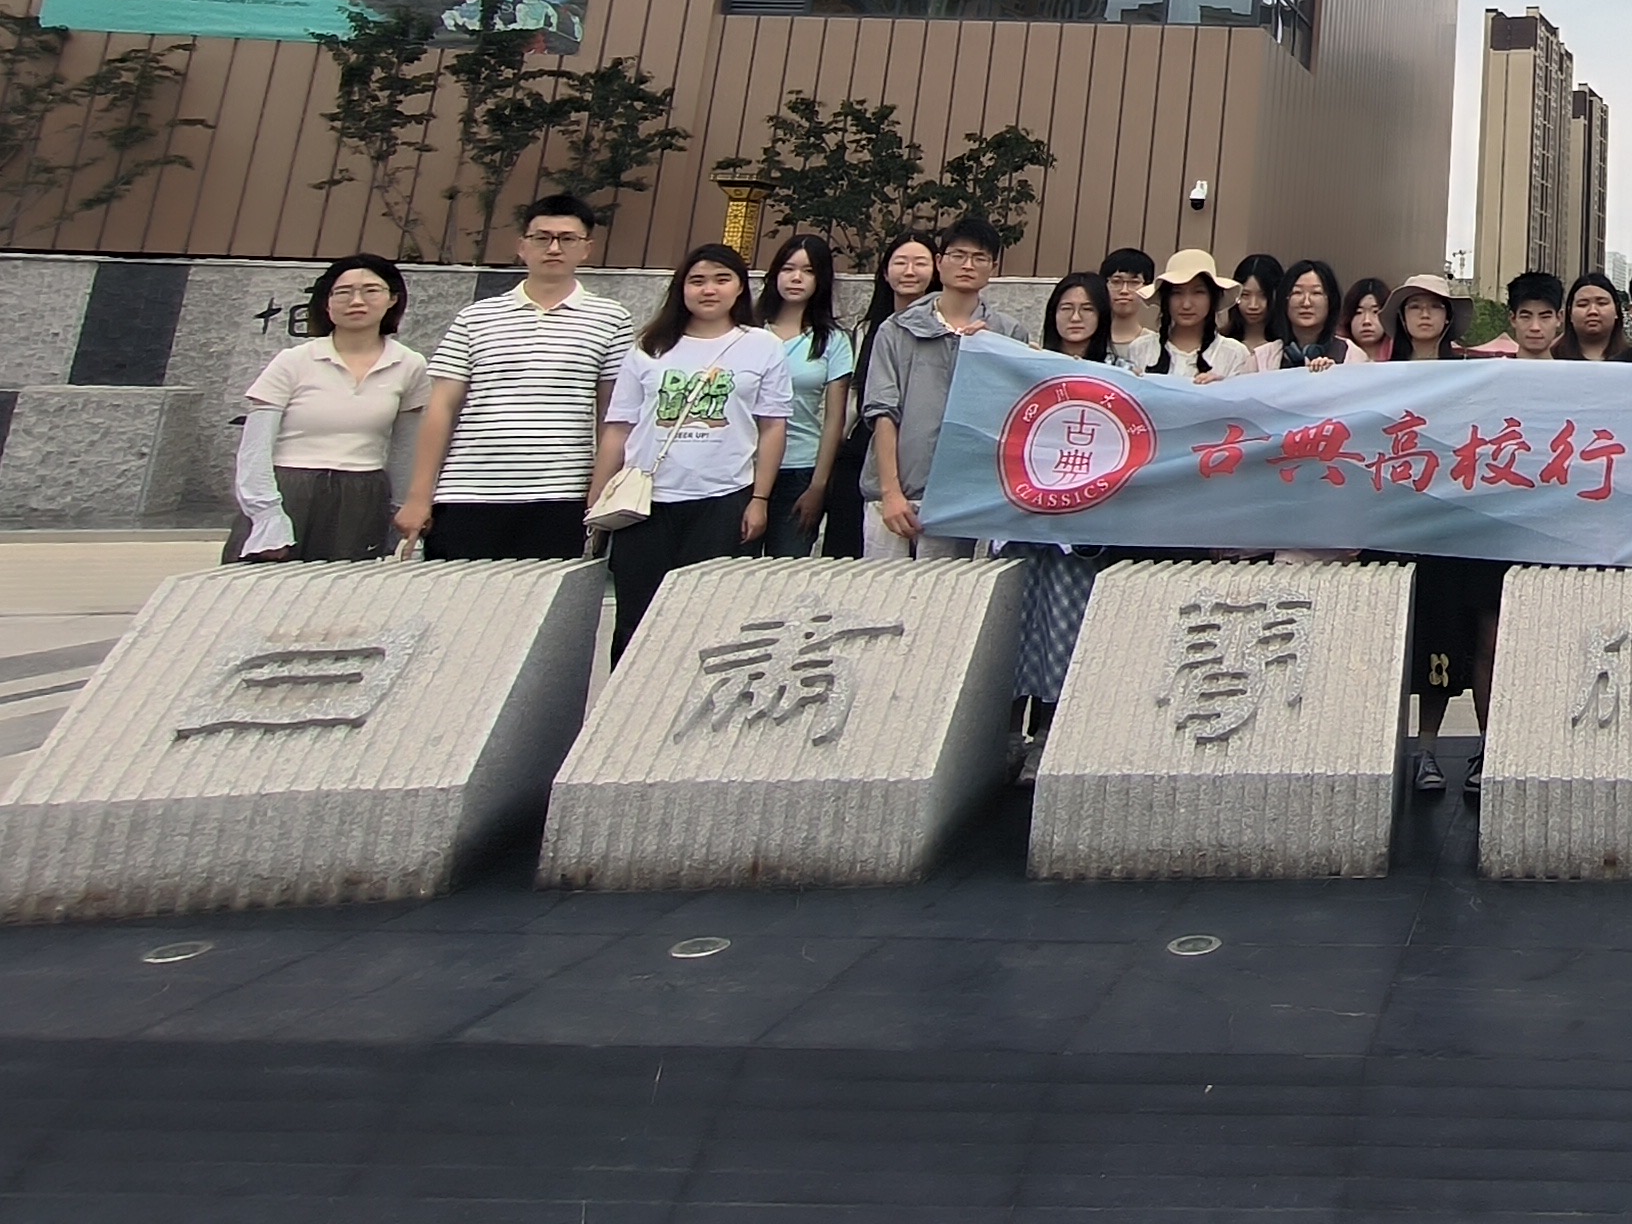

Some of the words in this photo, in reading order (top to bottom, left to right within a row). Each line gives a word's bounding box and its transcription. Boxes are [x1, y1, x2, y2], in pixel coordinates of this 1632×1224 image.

[1191, 408, 1627, 501] 古典高校行
[1015, 477, 1109, 508] CLASSICS
